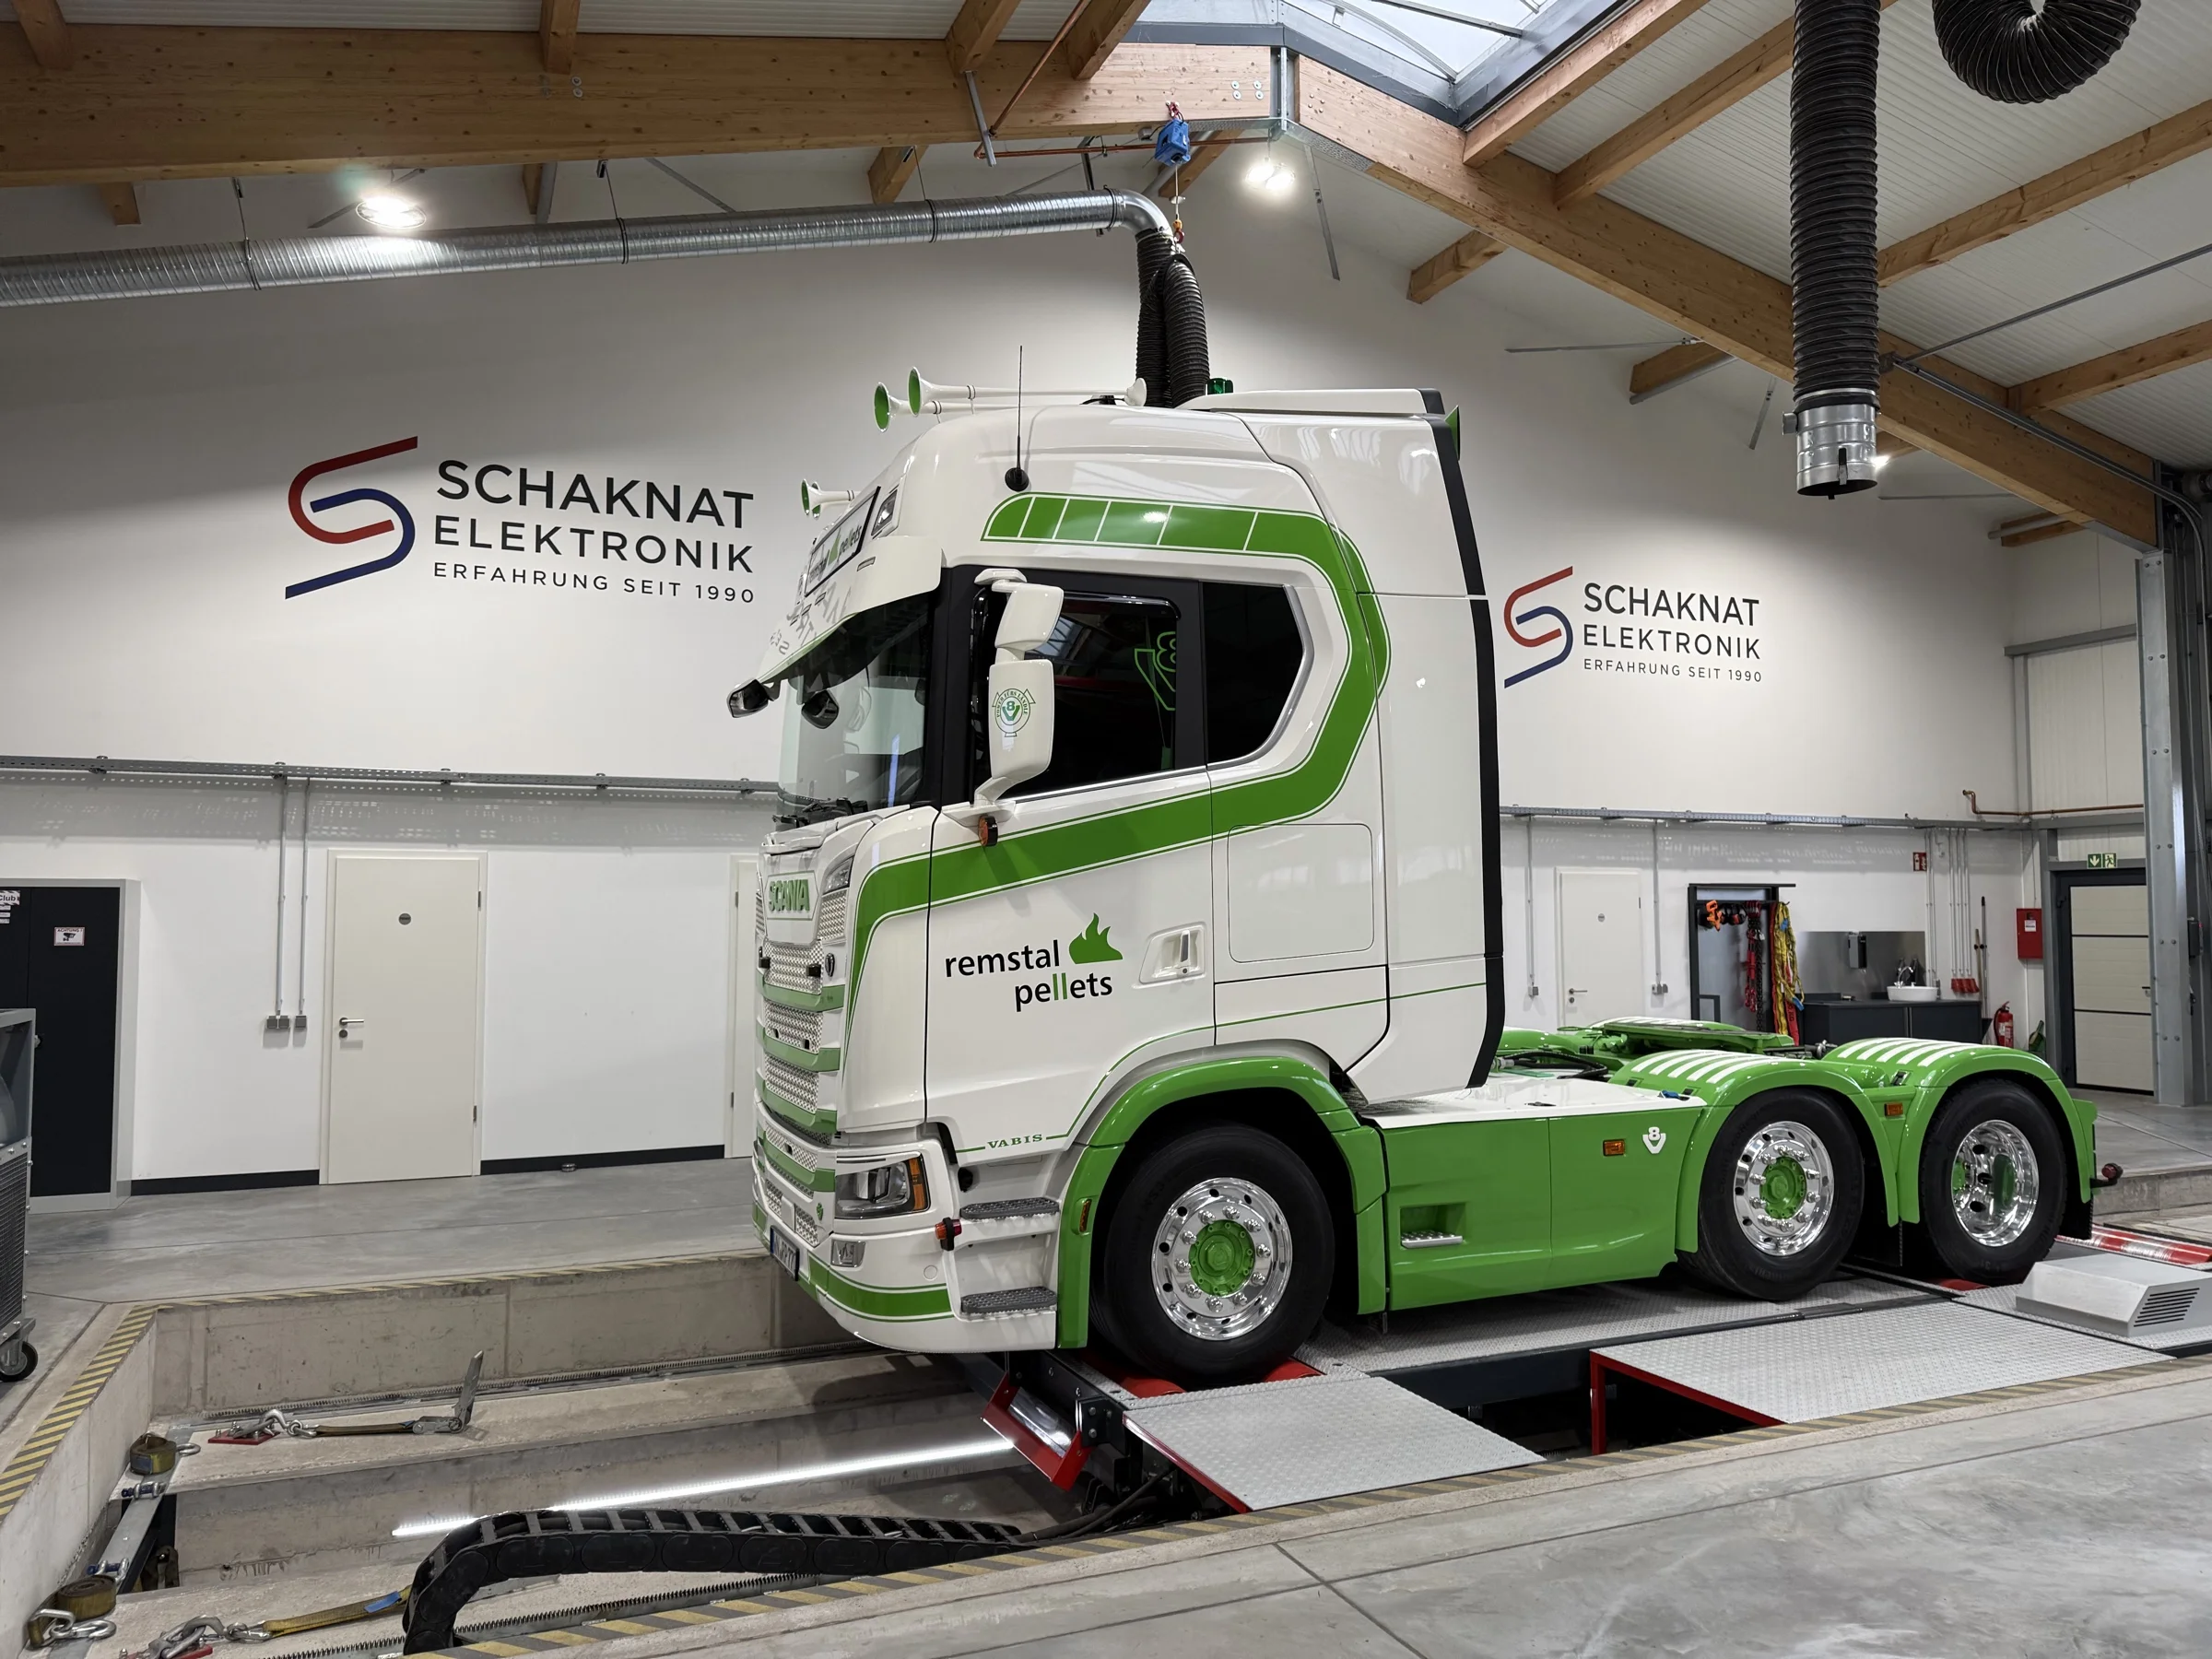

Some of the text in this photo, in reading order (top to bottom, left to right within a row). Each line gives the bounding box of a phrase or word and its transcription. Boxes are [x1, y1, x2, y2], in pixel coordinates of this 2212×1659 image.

[437, 459, 754, 529] SCHAKNAT
[435, 514, 754, 573] ELEKTRONIK
[434, 562, 754, 604] ERFAHRUNG SEIT 1990
[1583, 582, 1759, 627] SCHAKNAT
[1583, 624, 1760, 660] ELEKTRONIK
[1583, 658, 1762, 682] ERFAHRUNG SEIT 1990
[769, 878, 811, 912] SCANIA
[945, 939, 1060, 977] remstal
[1015, 972, 1112, 1012] pellets
[987, 1134, 1043, 1149] VABIS
[1641, 1126, 1666, 1154] V8
